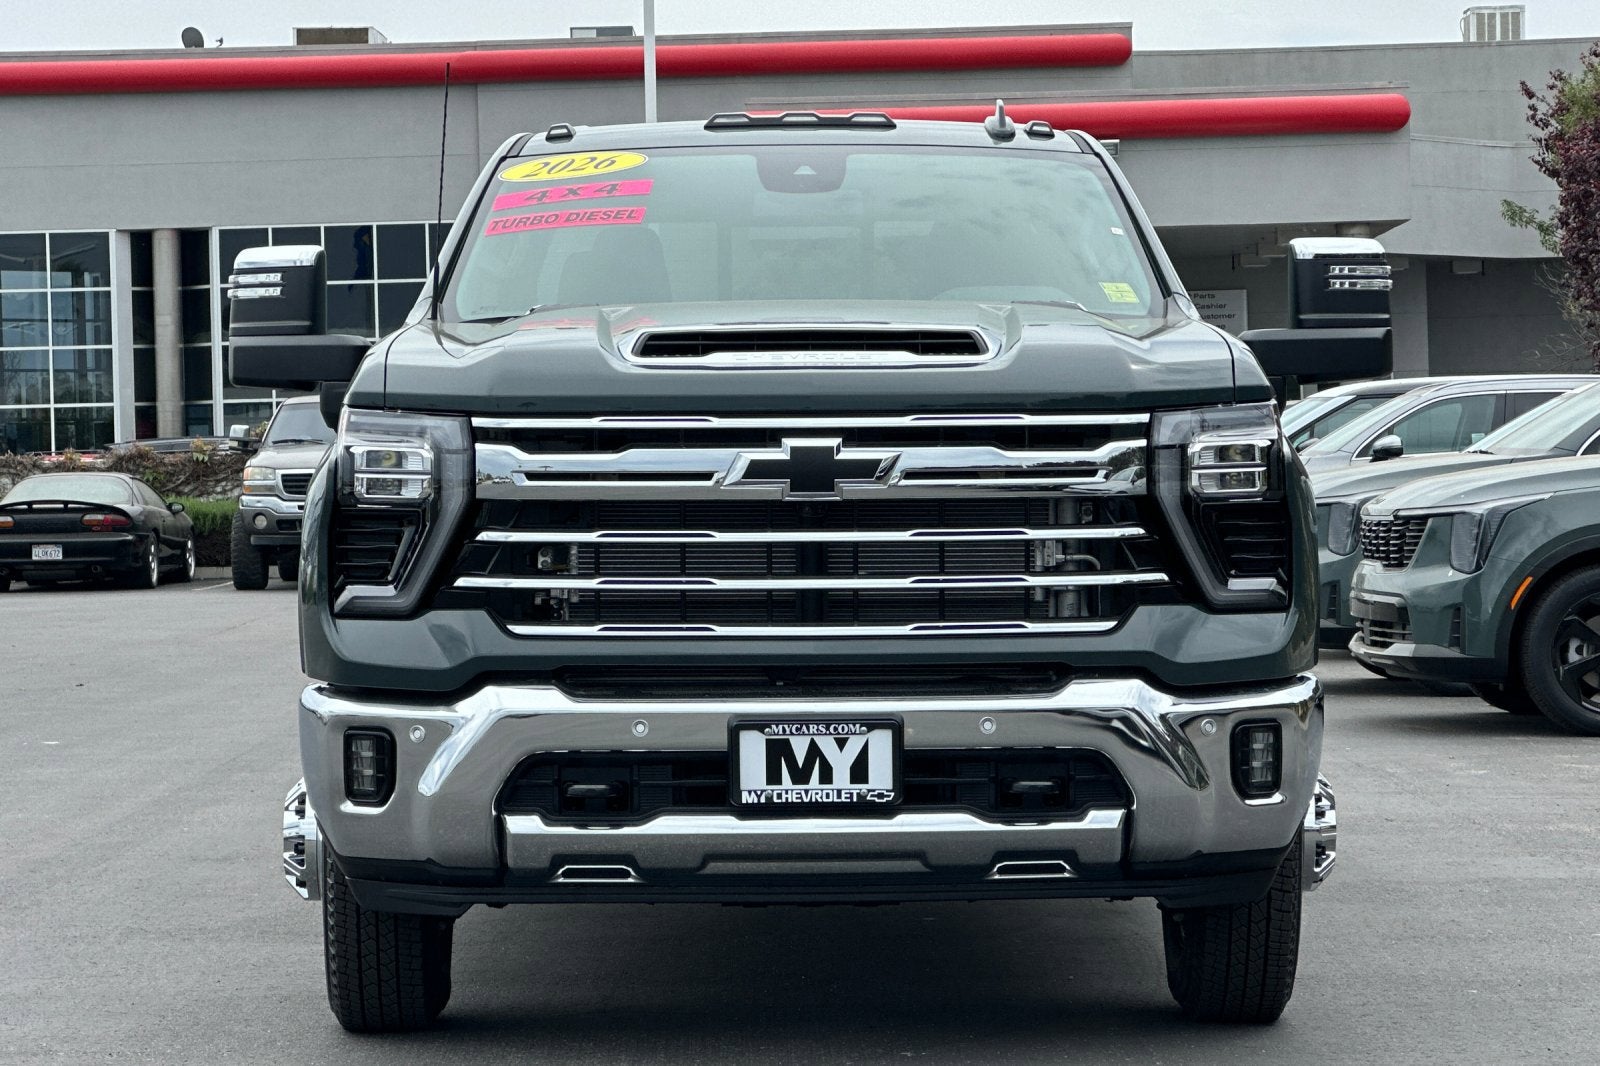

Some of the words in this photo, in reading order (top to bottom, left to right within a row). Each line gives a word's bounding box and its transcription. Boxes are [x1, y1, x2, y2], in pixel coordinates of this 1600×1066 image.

[520, 154, 622, 178] 2026
[491, 213, 560, 231] TURBO
[564, 208, 639, 223] DIESEL
[770, 723, 860, 735] MYCARS.COM
[765, 737, 869, 786] MY
[741, 790, 766, 804] MY
[773, 789, 860, 803] CHEVROLET
